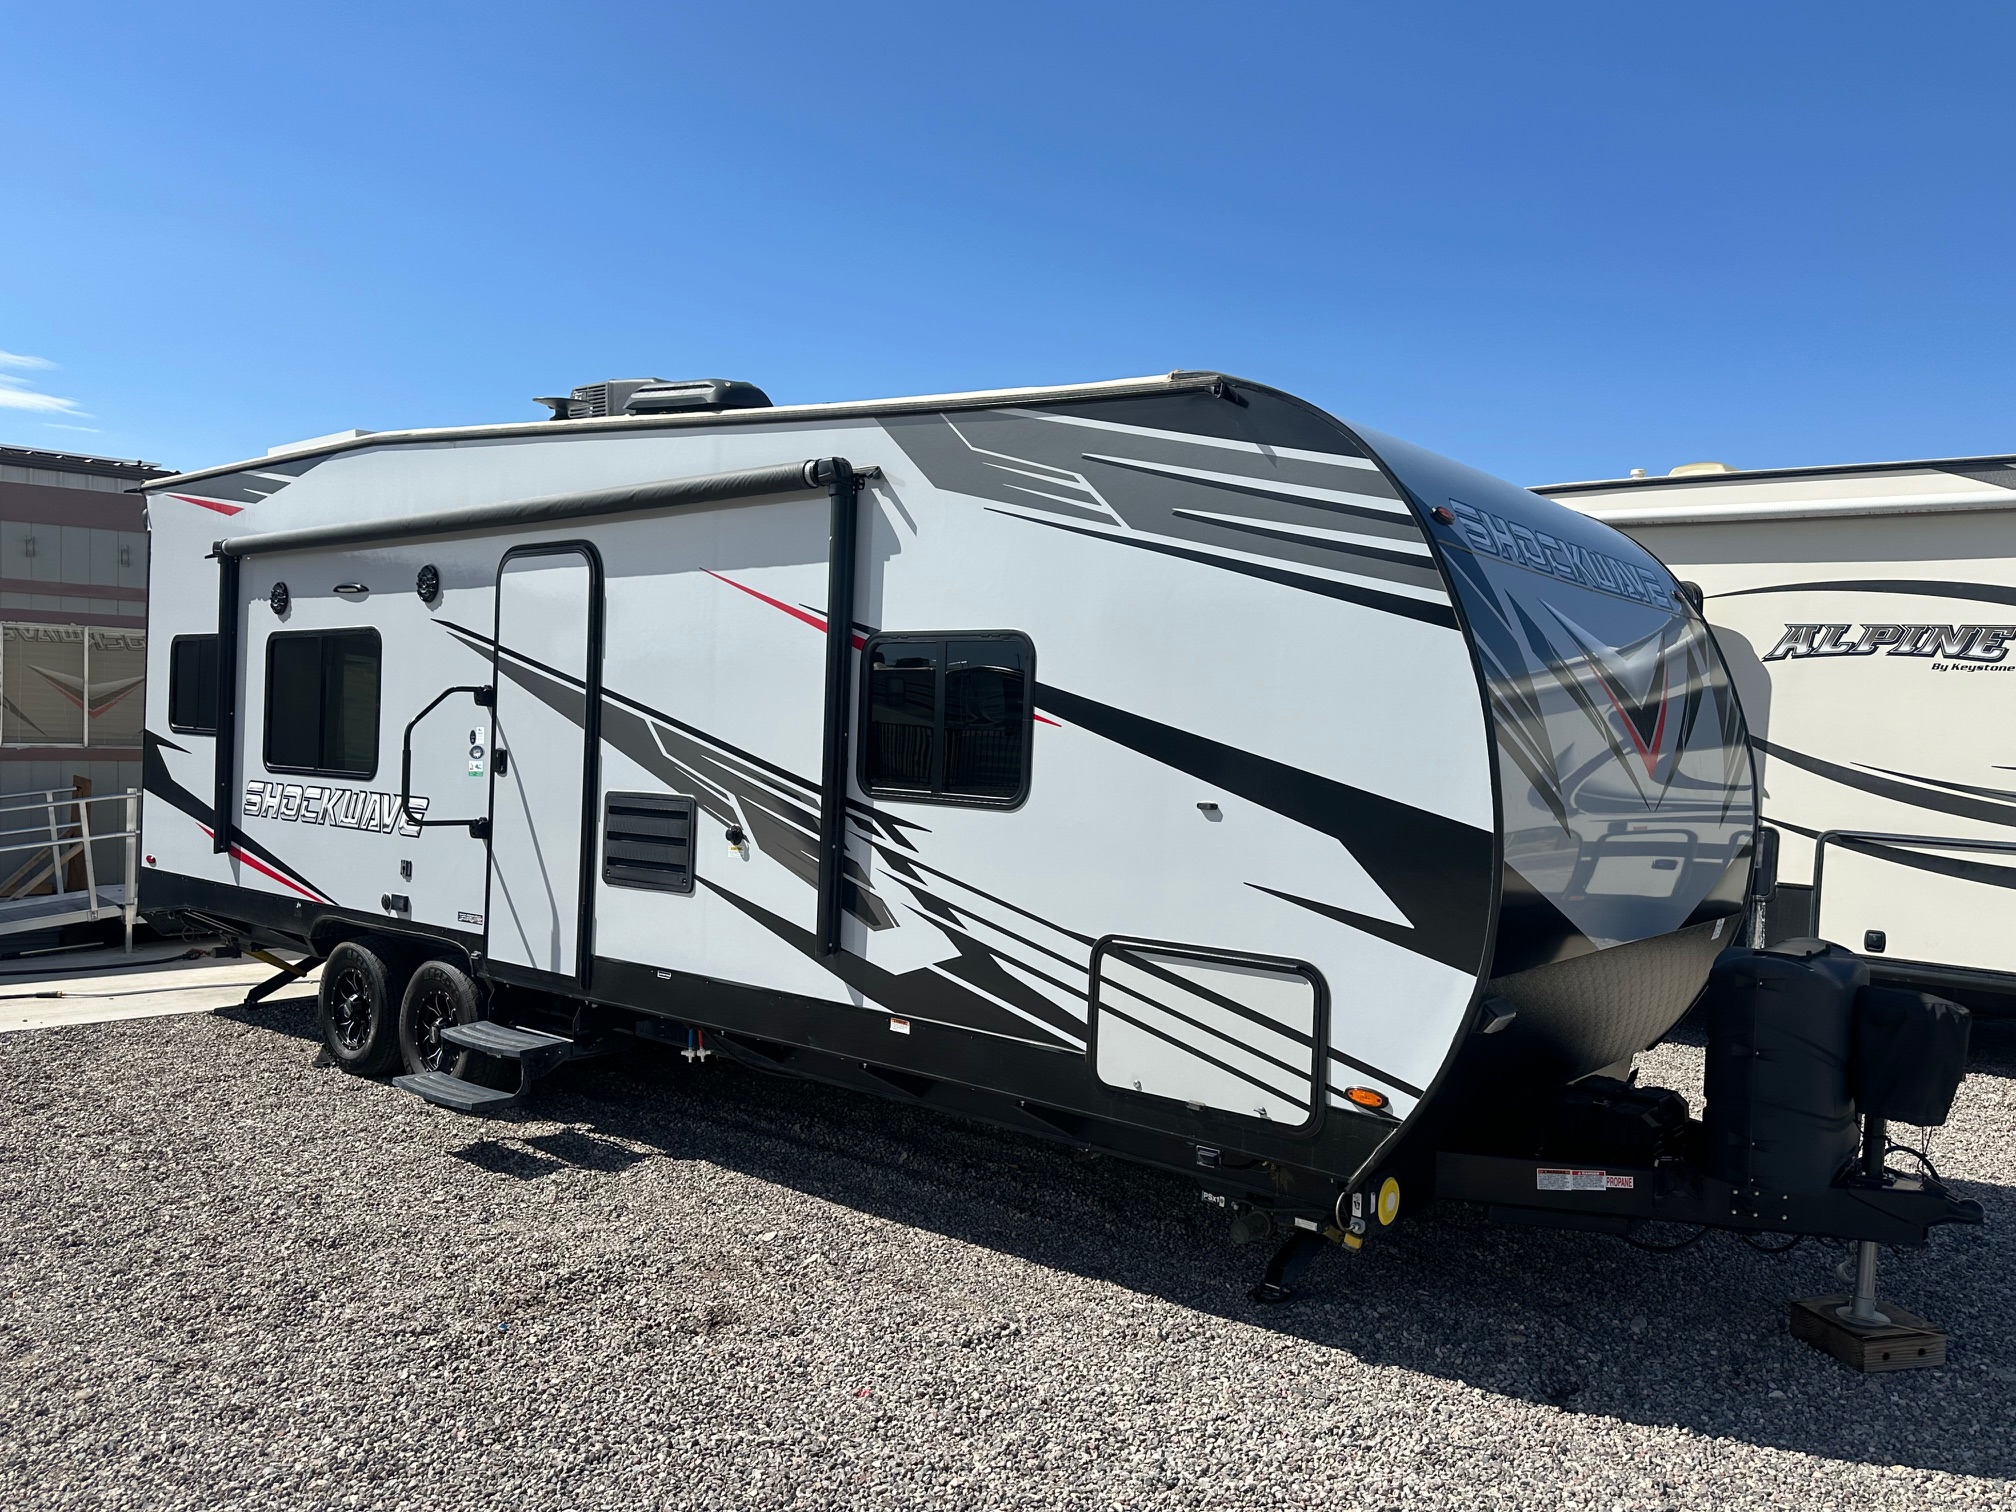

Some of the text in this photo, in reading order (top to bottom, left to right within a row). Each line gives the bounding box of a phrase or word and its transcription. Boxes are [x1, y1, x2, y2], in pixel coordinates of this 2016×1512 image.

[1448, 498, 1673, 611] SHOCKWAVE
[1761, 623, 2016, 663] ALPINE
[1931, 662, 2016, 673] By Keystone
[243, 780, 430, 838] SHOCKWAVE
[1606, 1177, 1633, 1187] PROPANE
